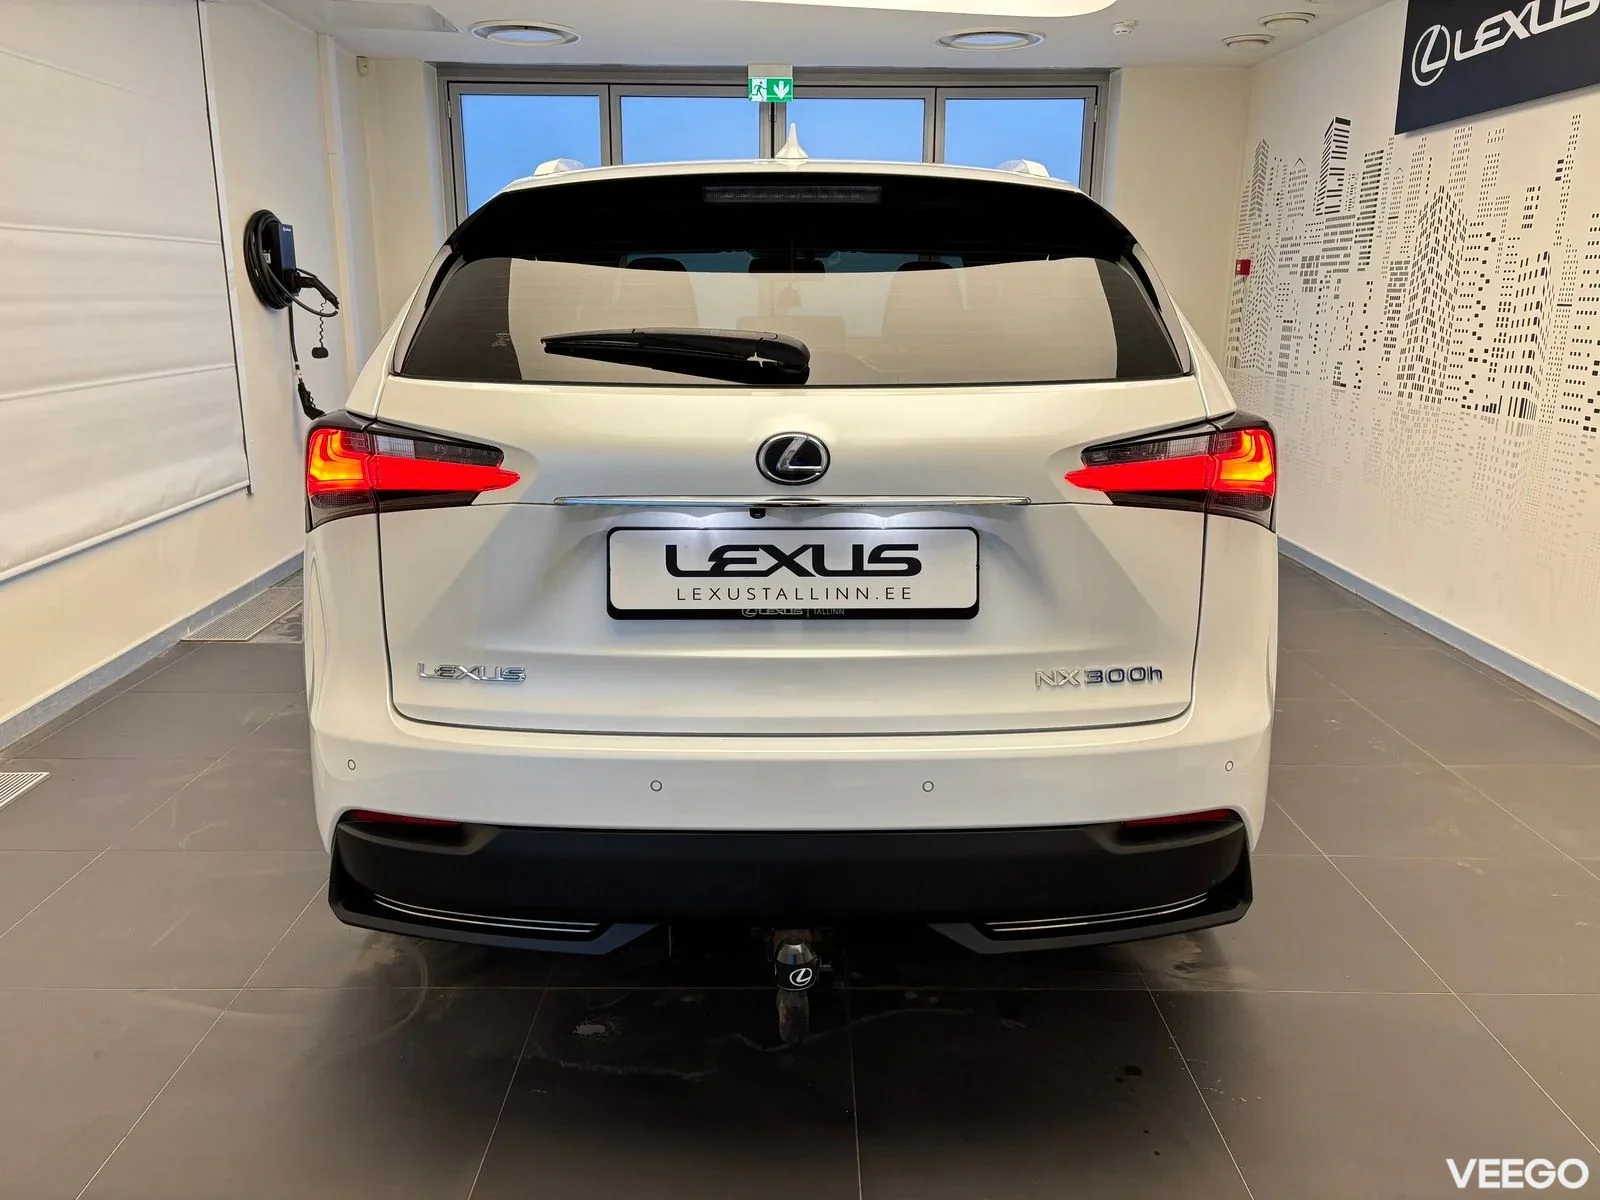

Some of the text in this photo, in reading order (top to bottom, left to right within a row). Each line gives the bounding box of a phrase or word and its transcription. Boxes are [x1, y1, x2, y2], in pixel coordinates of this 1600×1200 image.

[665, 543, 922, 577] LEXUS
[676, 586, 912, 601] LEXUSTALLINN.EE
[416, 662, 527, 682] LEXUS
